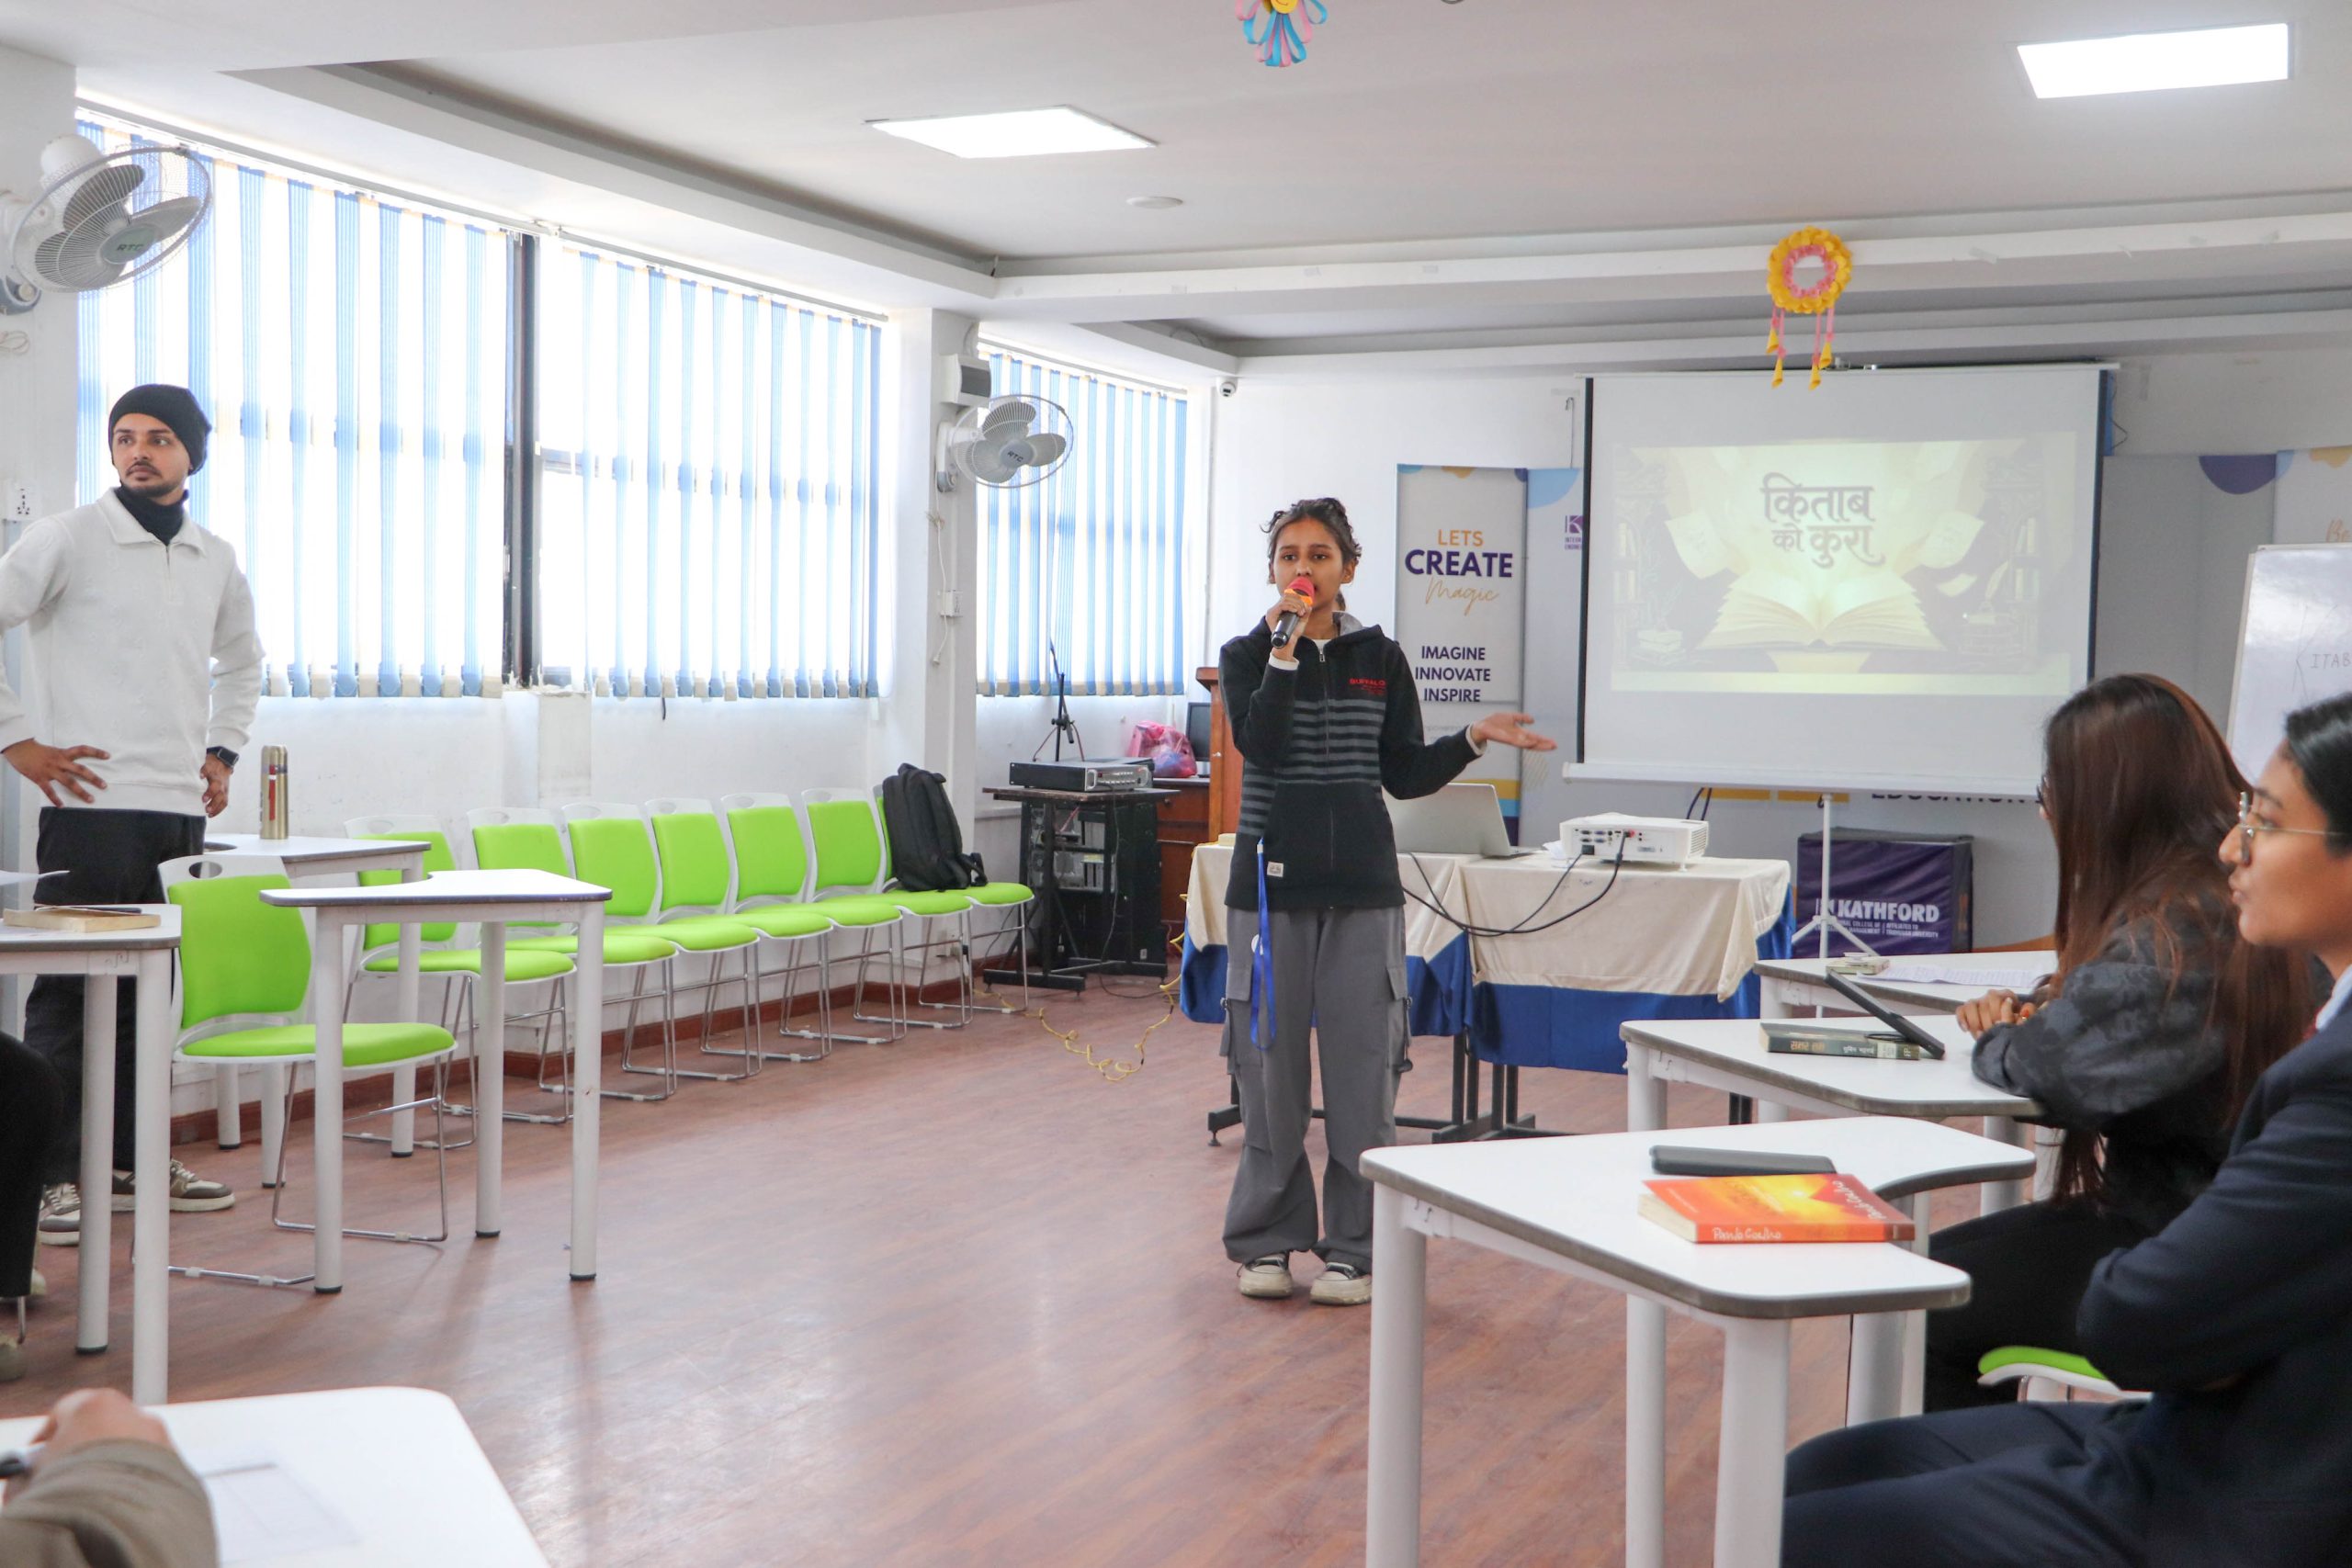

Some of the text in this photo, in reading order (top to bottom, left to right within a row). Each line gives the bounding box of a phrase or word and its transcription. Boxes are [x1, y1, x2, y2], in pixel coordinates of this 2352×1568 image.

[1759, 472, 1876, 522] किताब
[1438, 529, 1484, 547] LETS
[1806, 525, 1886, 569] कुरा
[1405, 549, 1513, 578] CREATE
[1426, 577, 1499, 616] Magic
[1421, 646, 1486, 660] IMAGINE
[1415, 667, 1491, 682] INNOVATE
[1424, 688, 1481, 703] INSPIRE
[1838, 899, 1939, 923] KATHFORD
